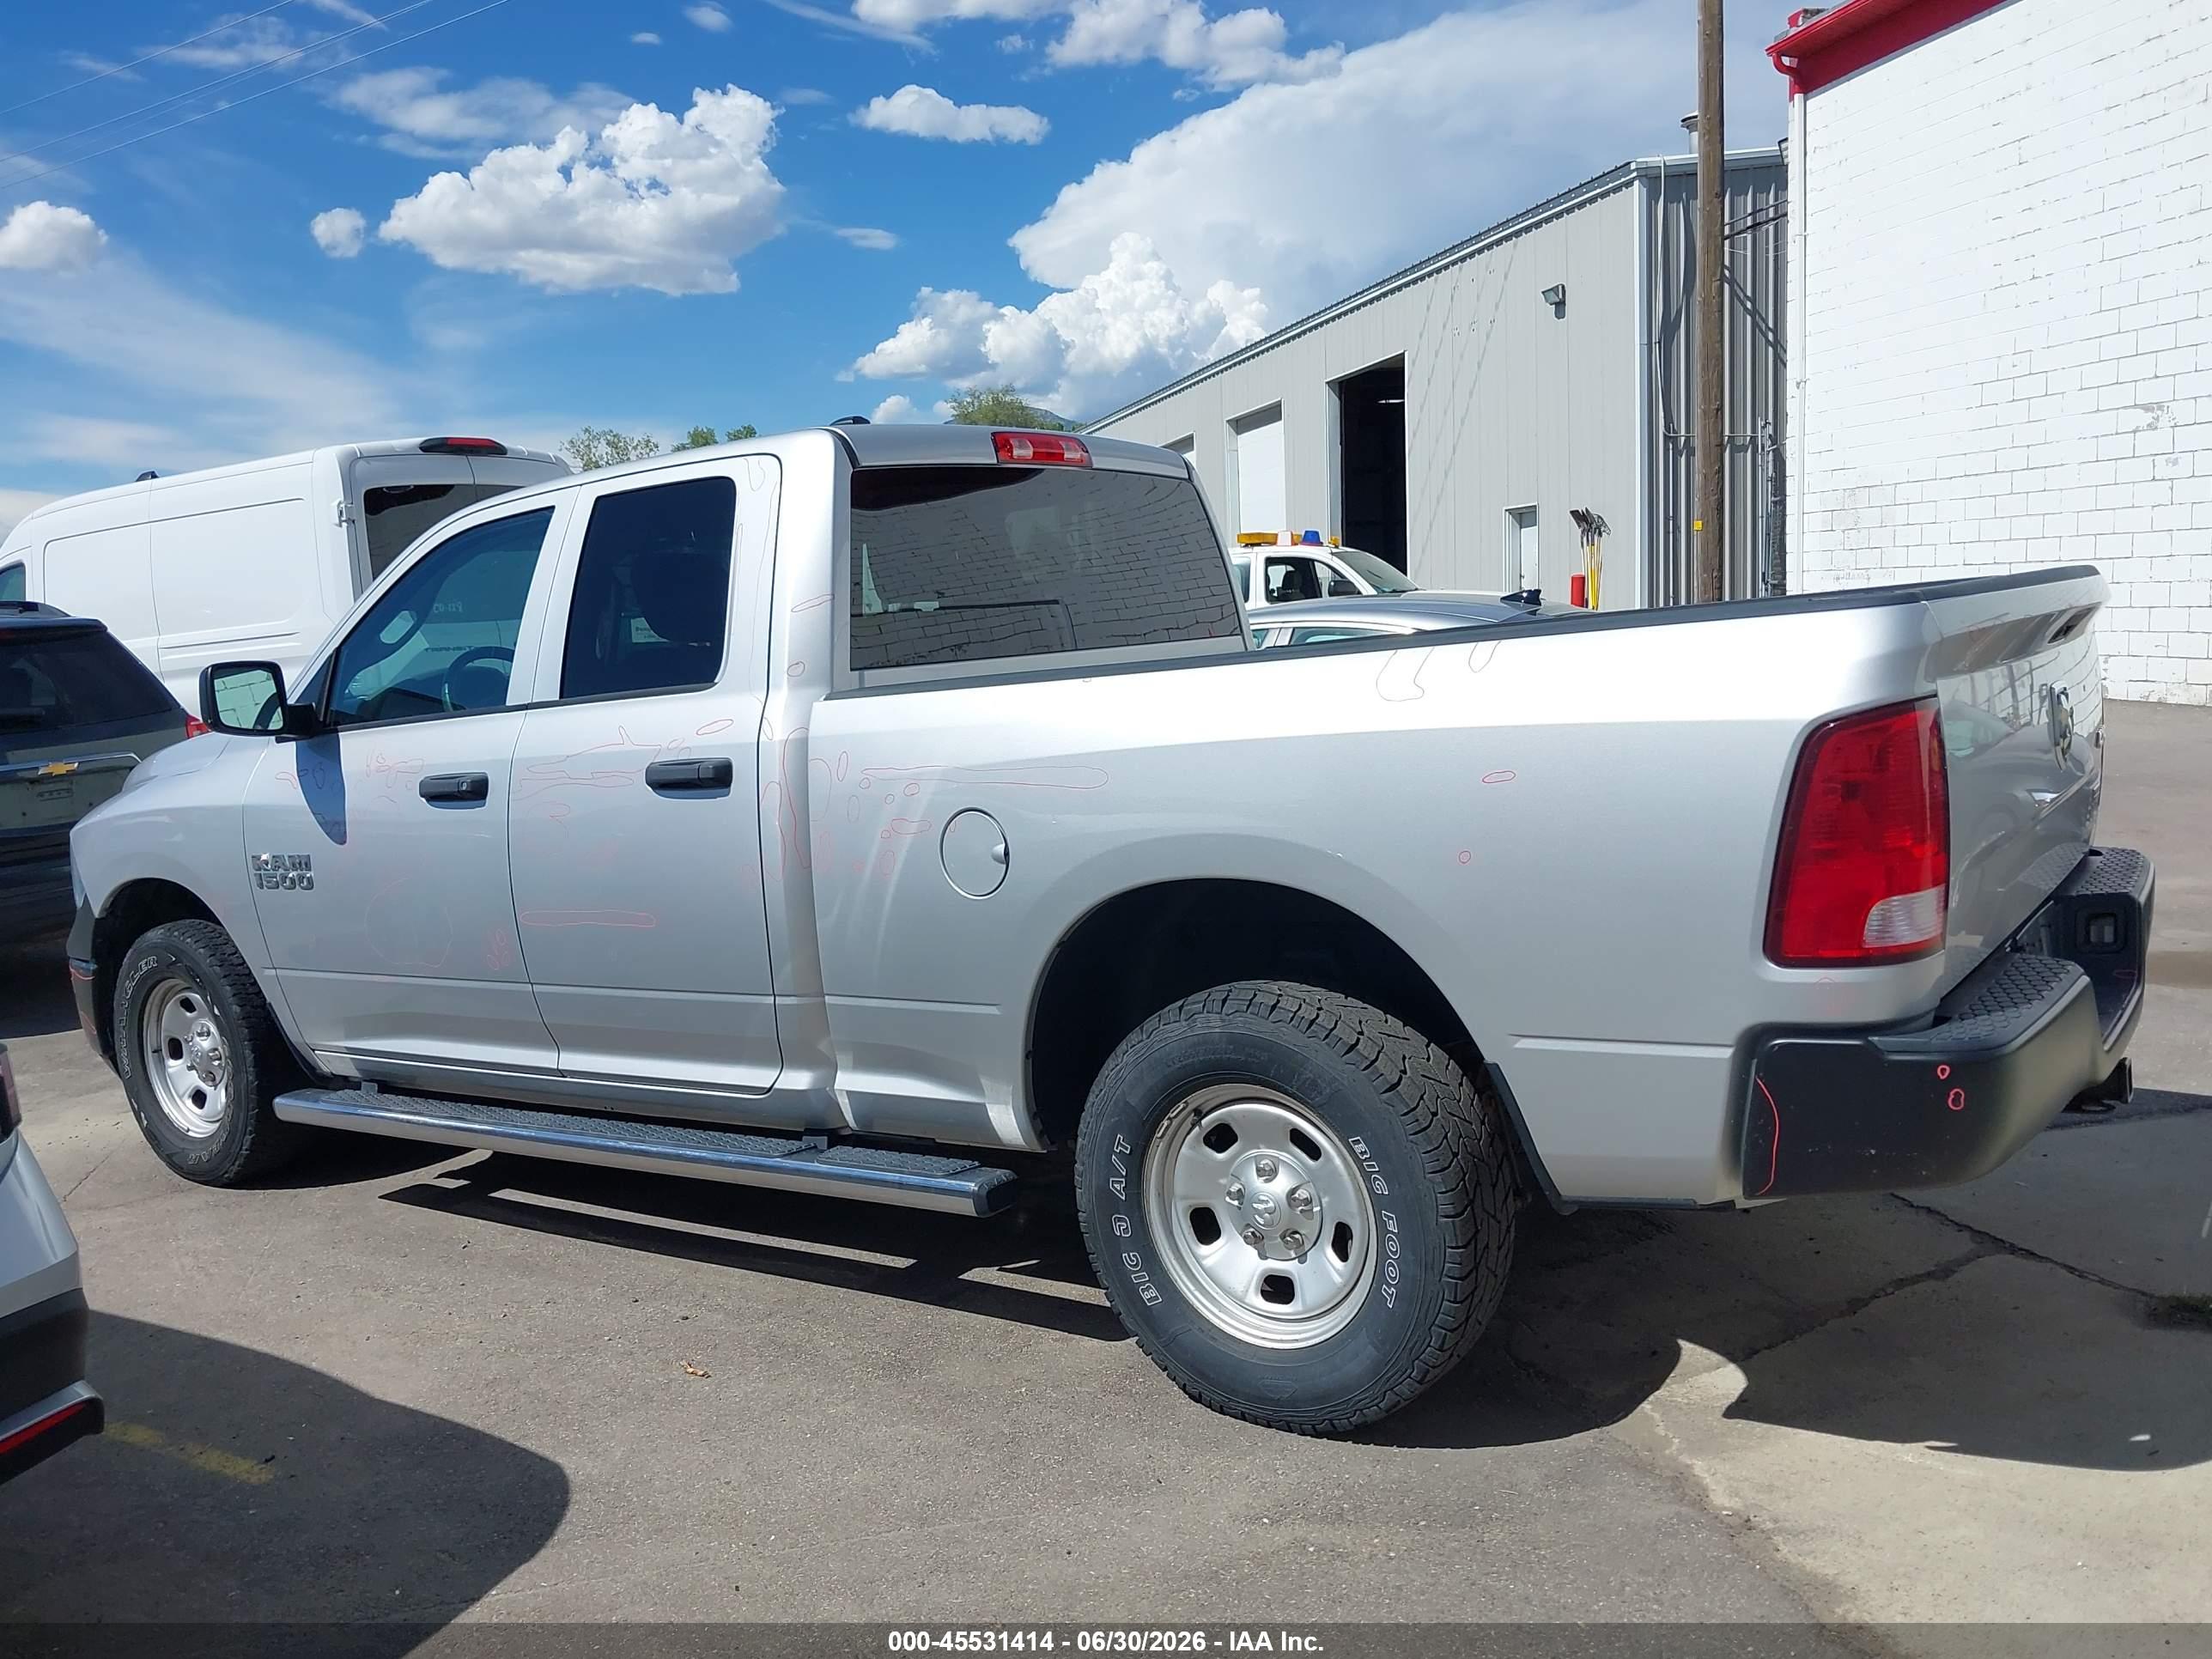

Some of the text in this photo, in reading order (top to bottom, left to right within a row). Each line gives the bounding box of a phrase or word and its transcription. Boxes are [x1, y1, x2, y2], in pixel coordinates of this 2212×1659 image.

[252, 854, 312, 872] RAM
[254, 872, 314, 890] 1500
[1109, 1133, 1131, 1200] A/T
[1348, 1136, 1401, 1309] BIG FOOT
[1122, 1251, 1162, 1305] BIG
